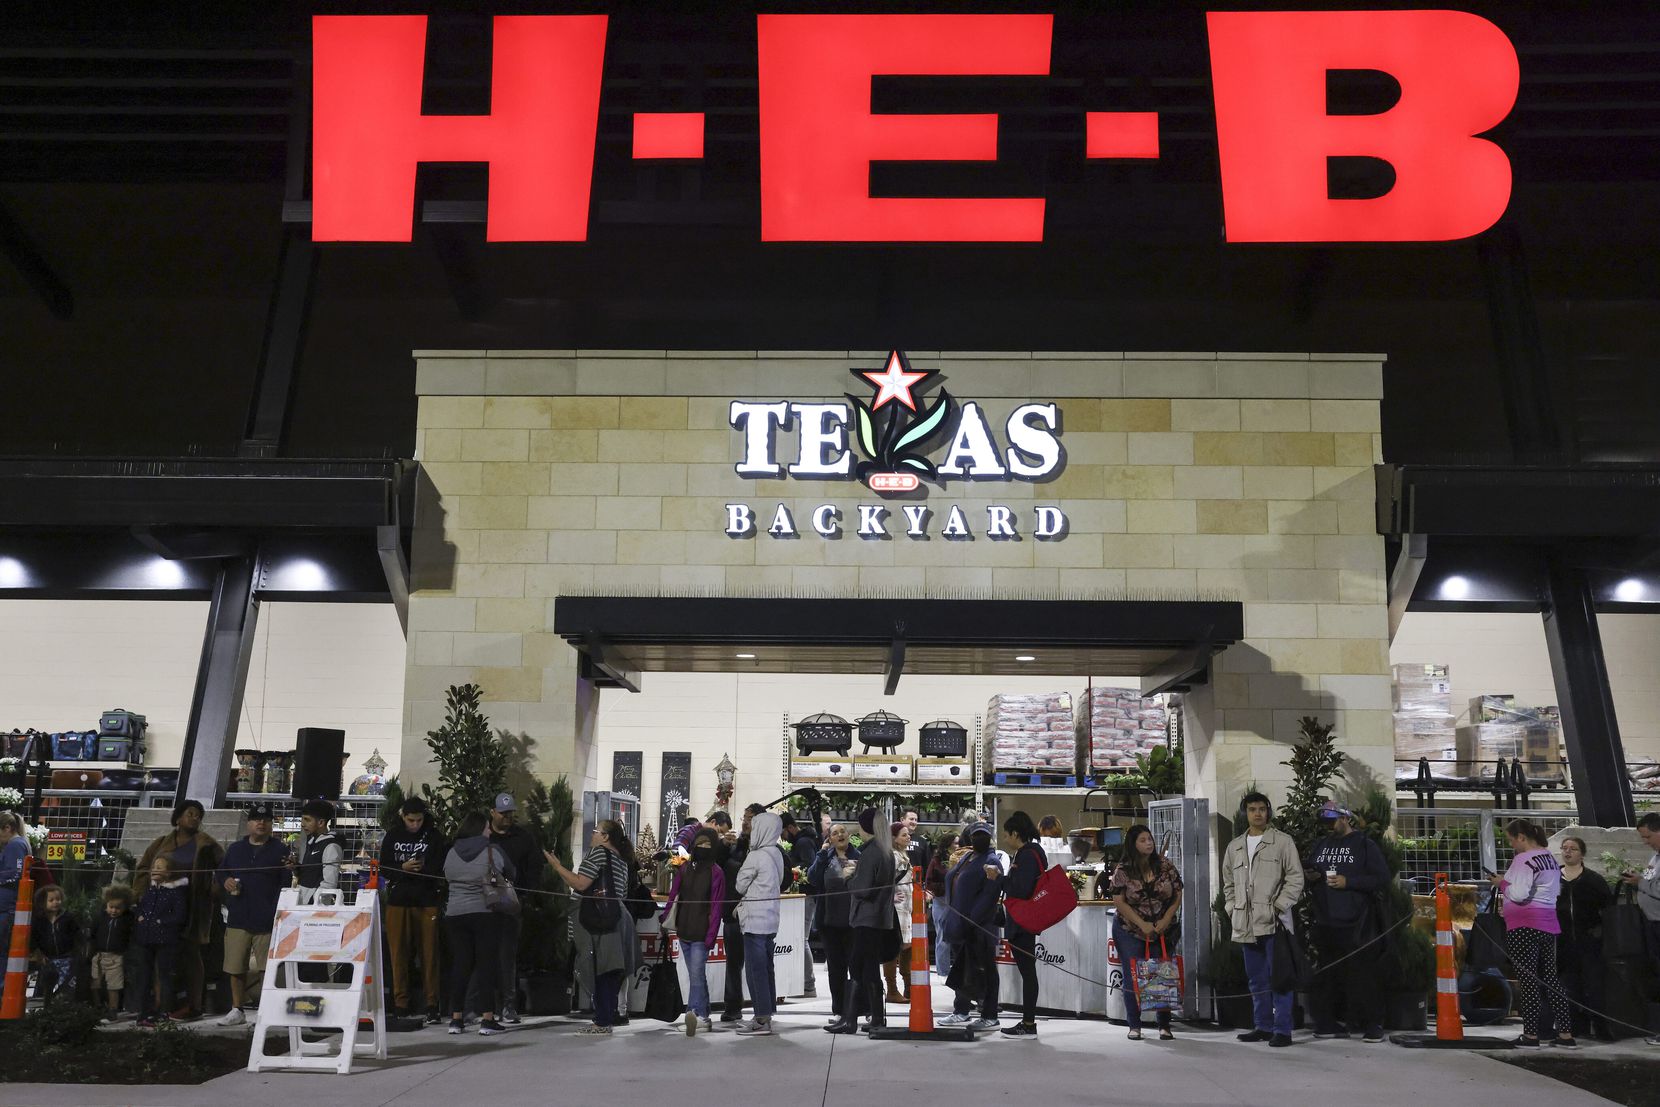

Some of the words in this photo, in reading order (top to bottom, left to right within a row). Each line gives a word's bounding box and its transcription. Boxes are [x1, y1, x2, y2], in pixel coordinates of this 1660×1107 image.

[312, 10, 1520, 243] H-E-B
[725, 504, 1063, 536] BACKYARD
[394, 842, 428, 852] OCCUPY
